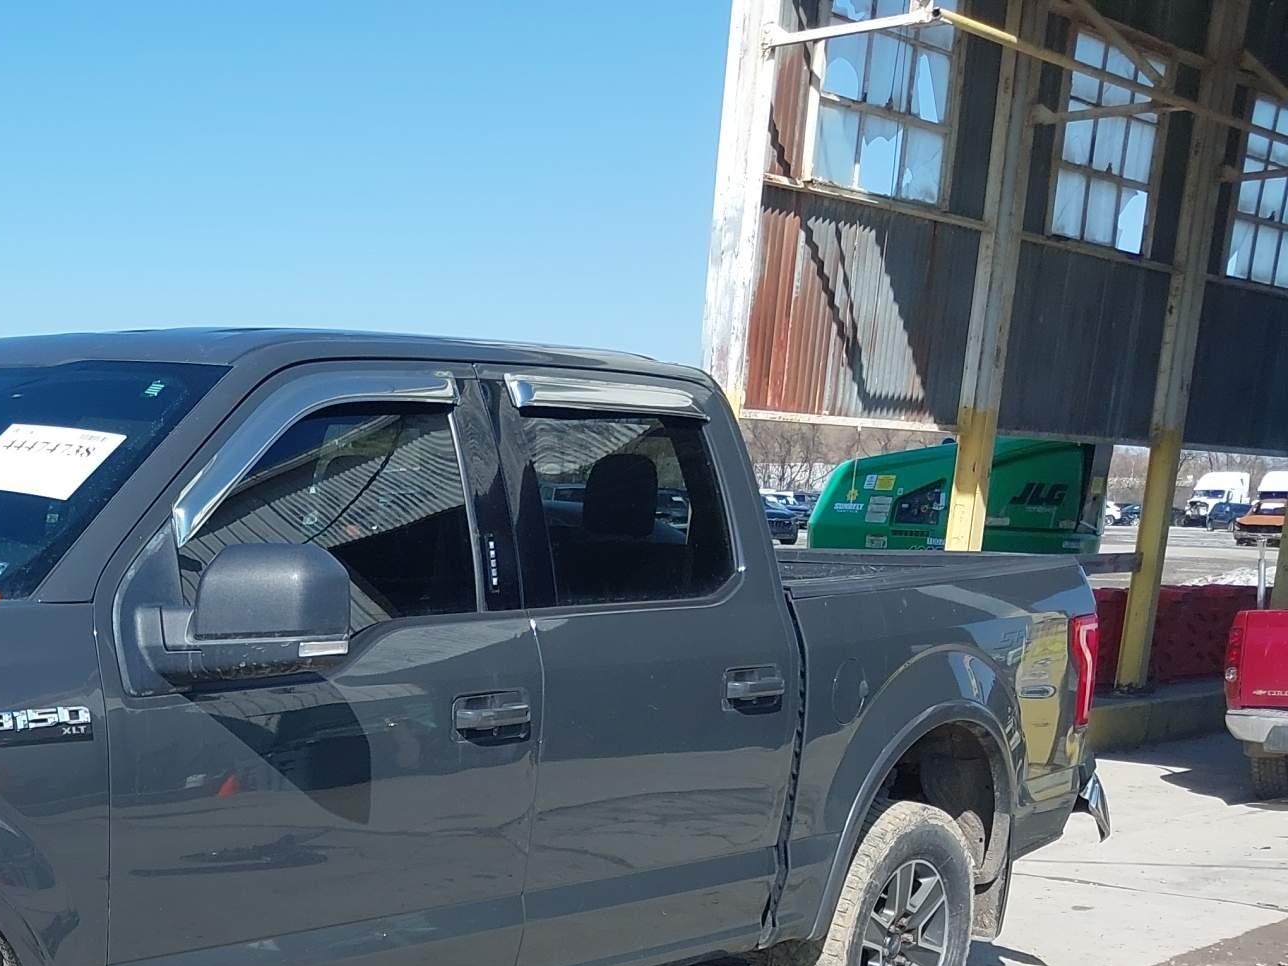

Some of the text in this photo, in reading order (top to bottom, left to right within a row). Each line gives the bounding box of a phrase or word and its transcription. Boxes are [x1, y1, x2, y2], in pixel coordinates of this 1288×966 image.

[3, 439, 97, 457] 44474738
[1009, 482, 1069, 505] JLG
[62, 725, 87, 735] XLT
